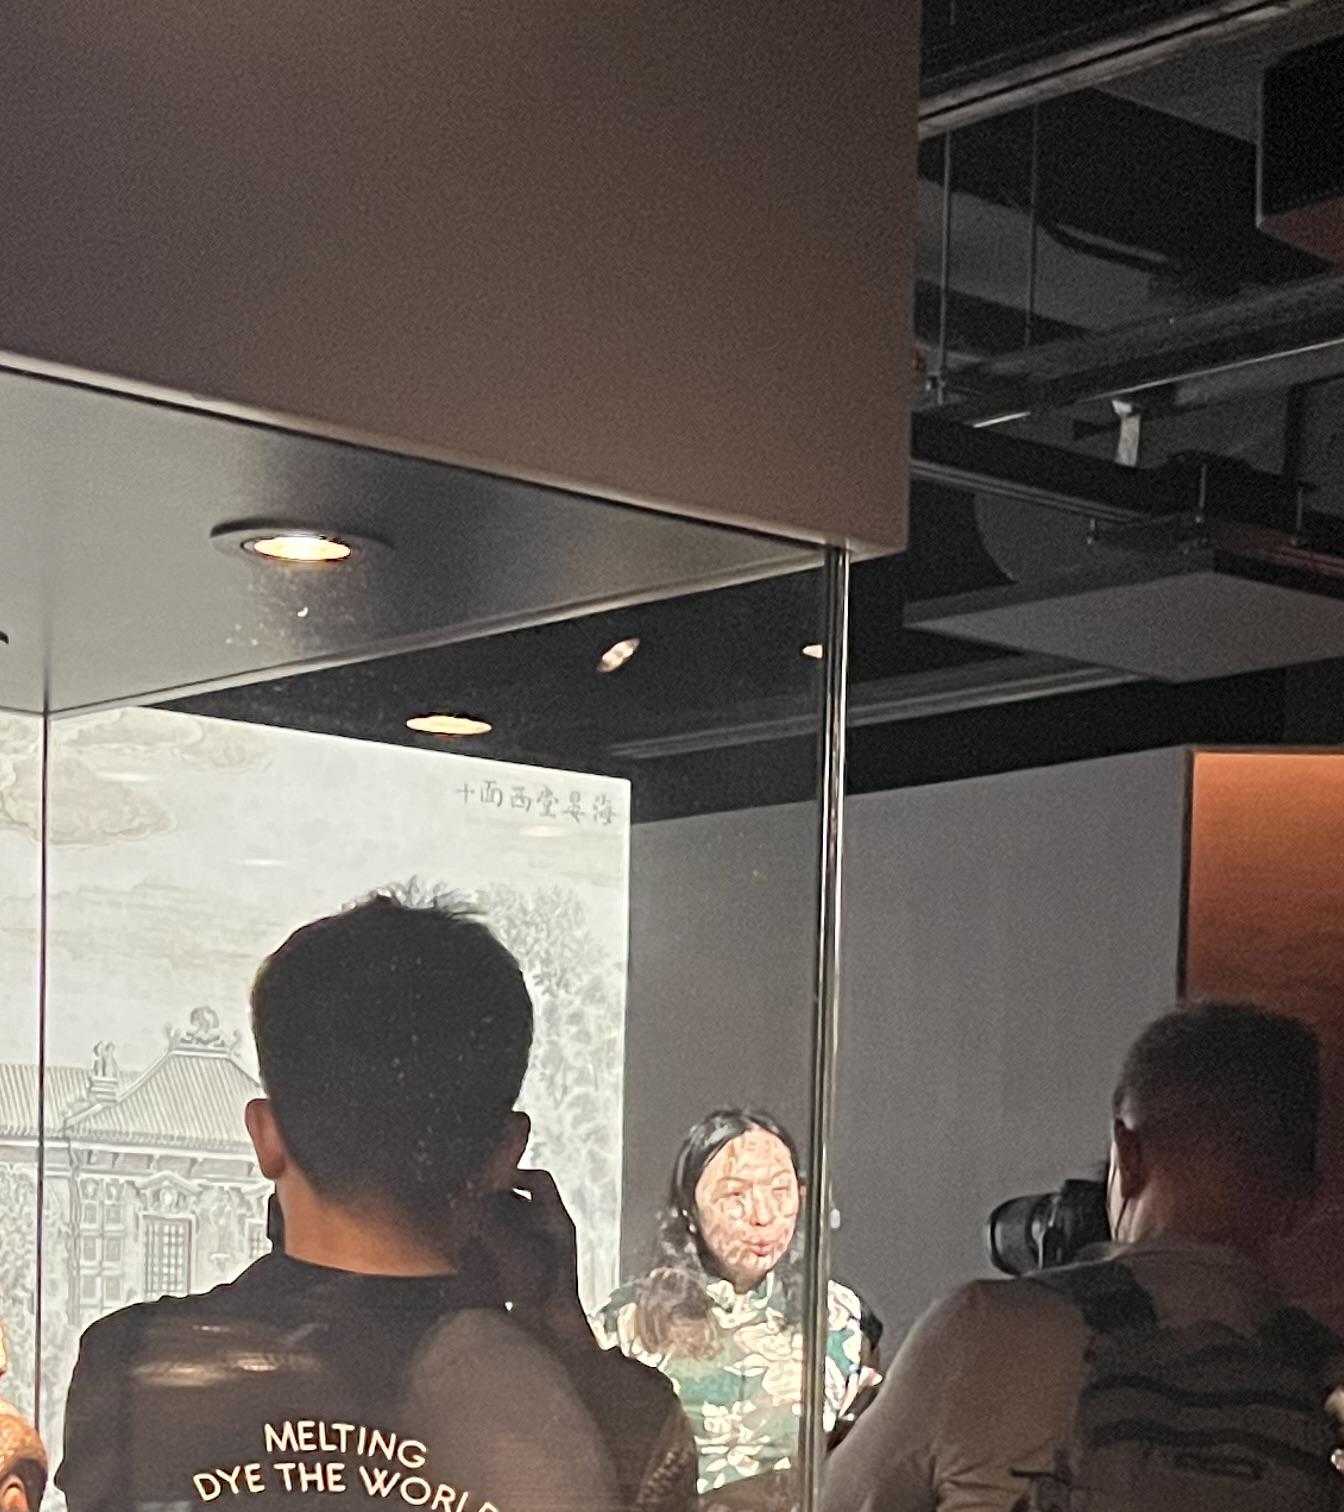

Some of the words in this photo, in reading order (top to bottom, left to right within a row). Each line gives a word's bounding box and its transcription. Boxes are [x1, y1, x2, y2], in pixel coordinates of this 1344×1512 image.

[264, 1420, 427, 1469] MELTING
[193, 1463, 265, 1501] DYE
[274, 1462, 346, 1492] THE
